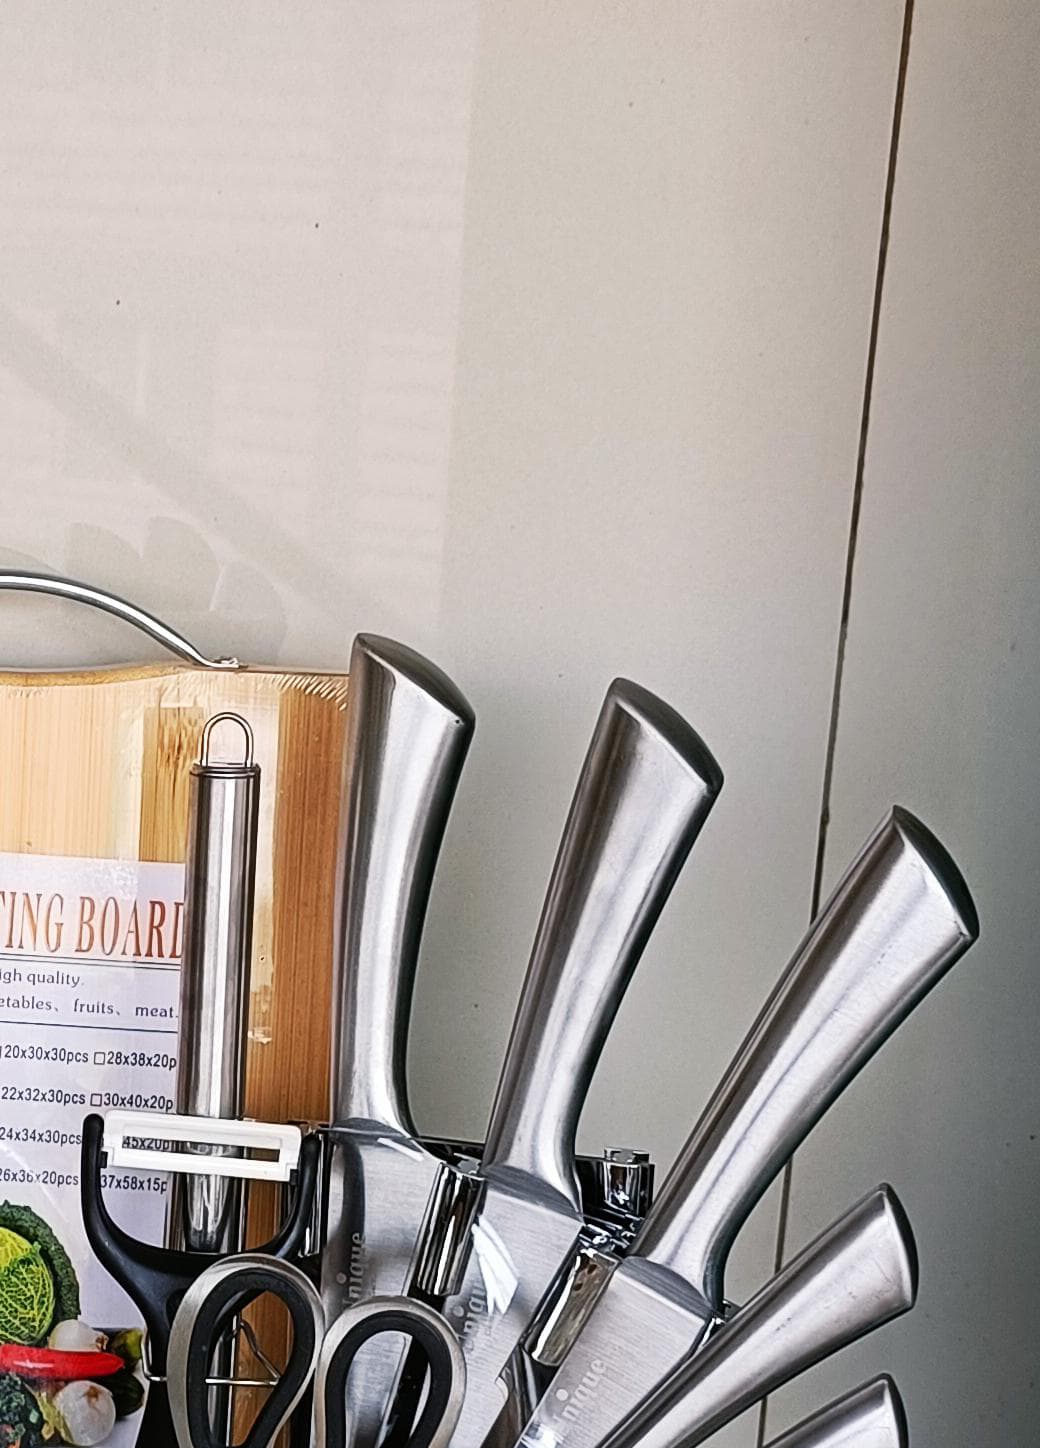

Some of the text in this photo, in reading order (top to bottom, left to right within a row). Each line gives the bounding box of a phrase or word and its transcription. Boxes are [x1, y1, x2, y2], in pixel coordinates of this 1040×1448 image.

[4, 1044, 89, 1065] 20x30x30pcs
[1, 1086, 86, 1107] 22x32x30pcs
[335, 1232, 367, 1307] nique
